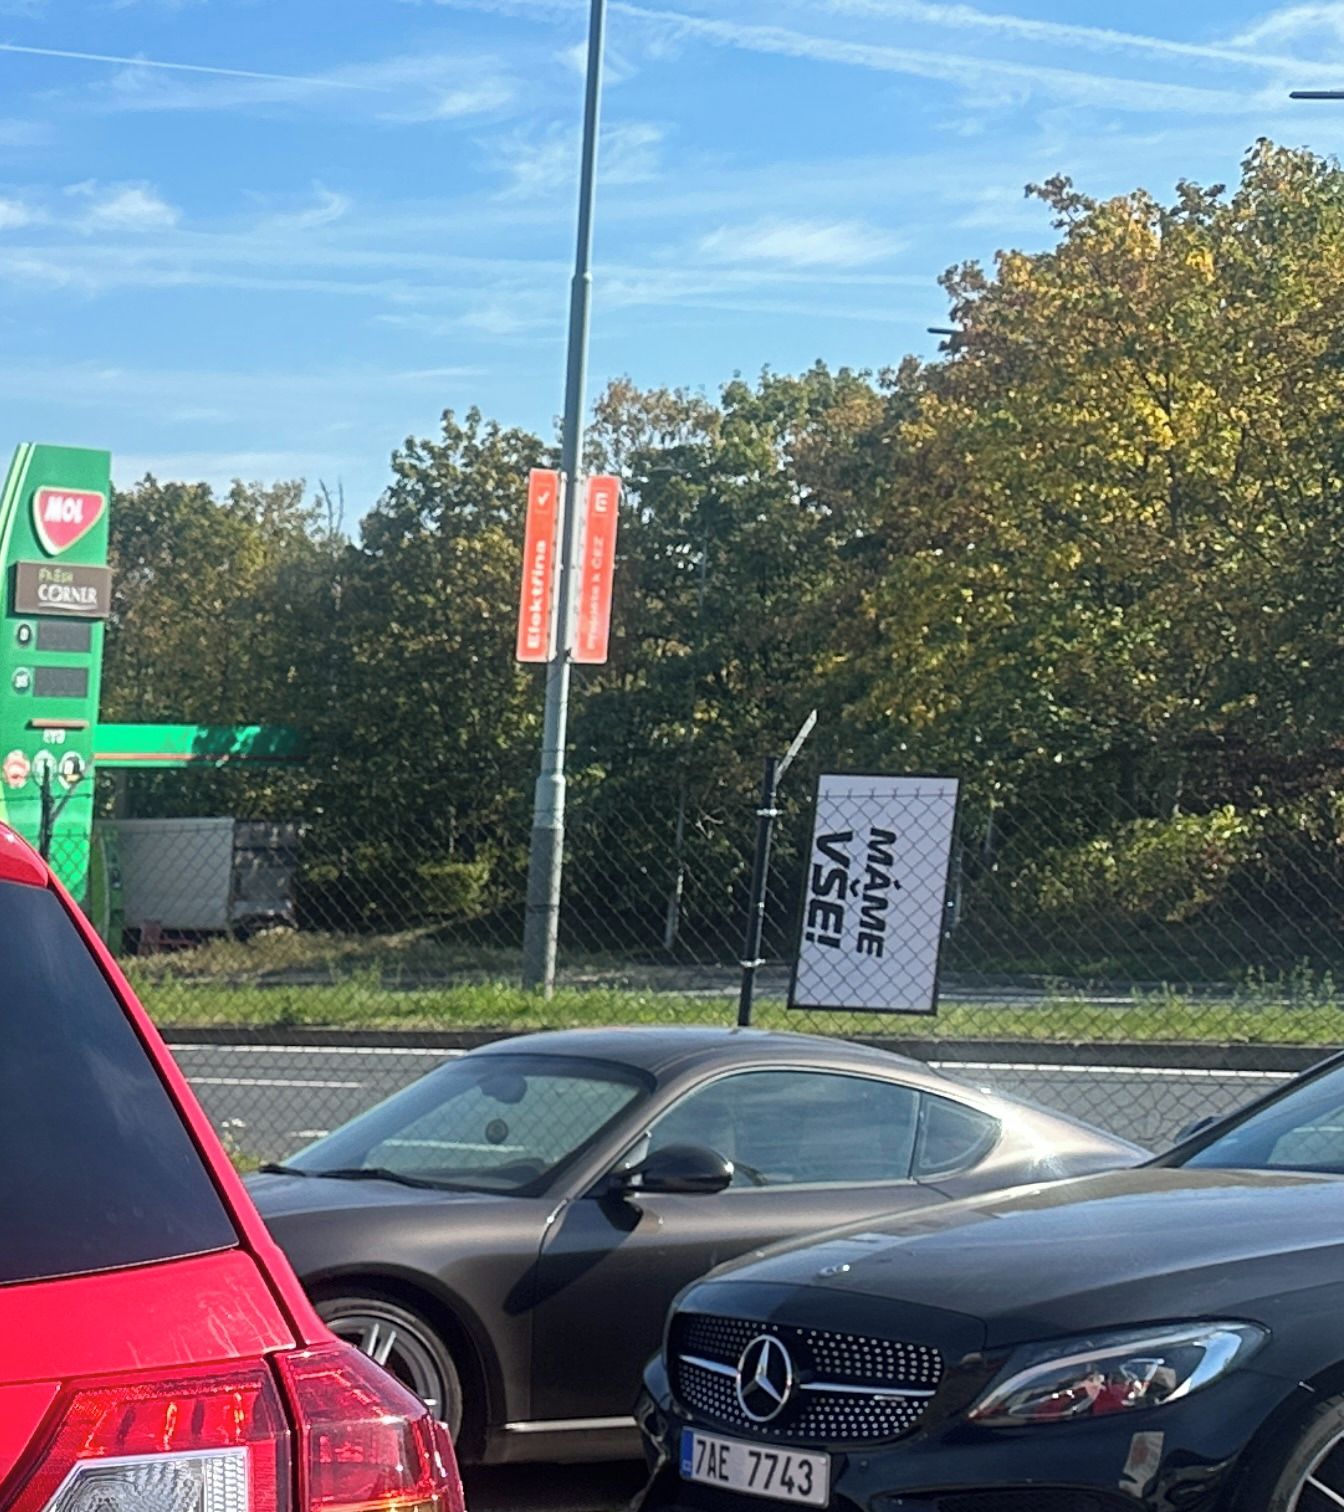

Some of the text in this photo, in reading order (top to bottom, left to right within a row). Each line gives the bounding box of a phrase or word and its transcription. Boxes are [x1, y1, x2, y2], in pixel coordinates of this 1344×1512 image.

[44, 496, 84, 523] MOL
[38, 584, 97, 605] CORNER
[805, 831, 861, 950] VŠE!
[856, 827, 902, 959] MÁME
[695, 1439, 814, 1497] 7AE 7743
